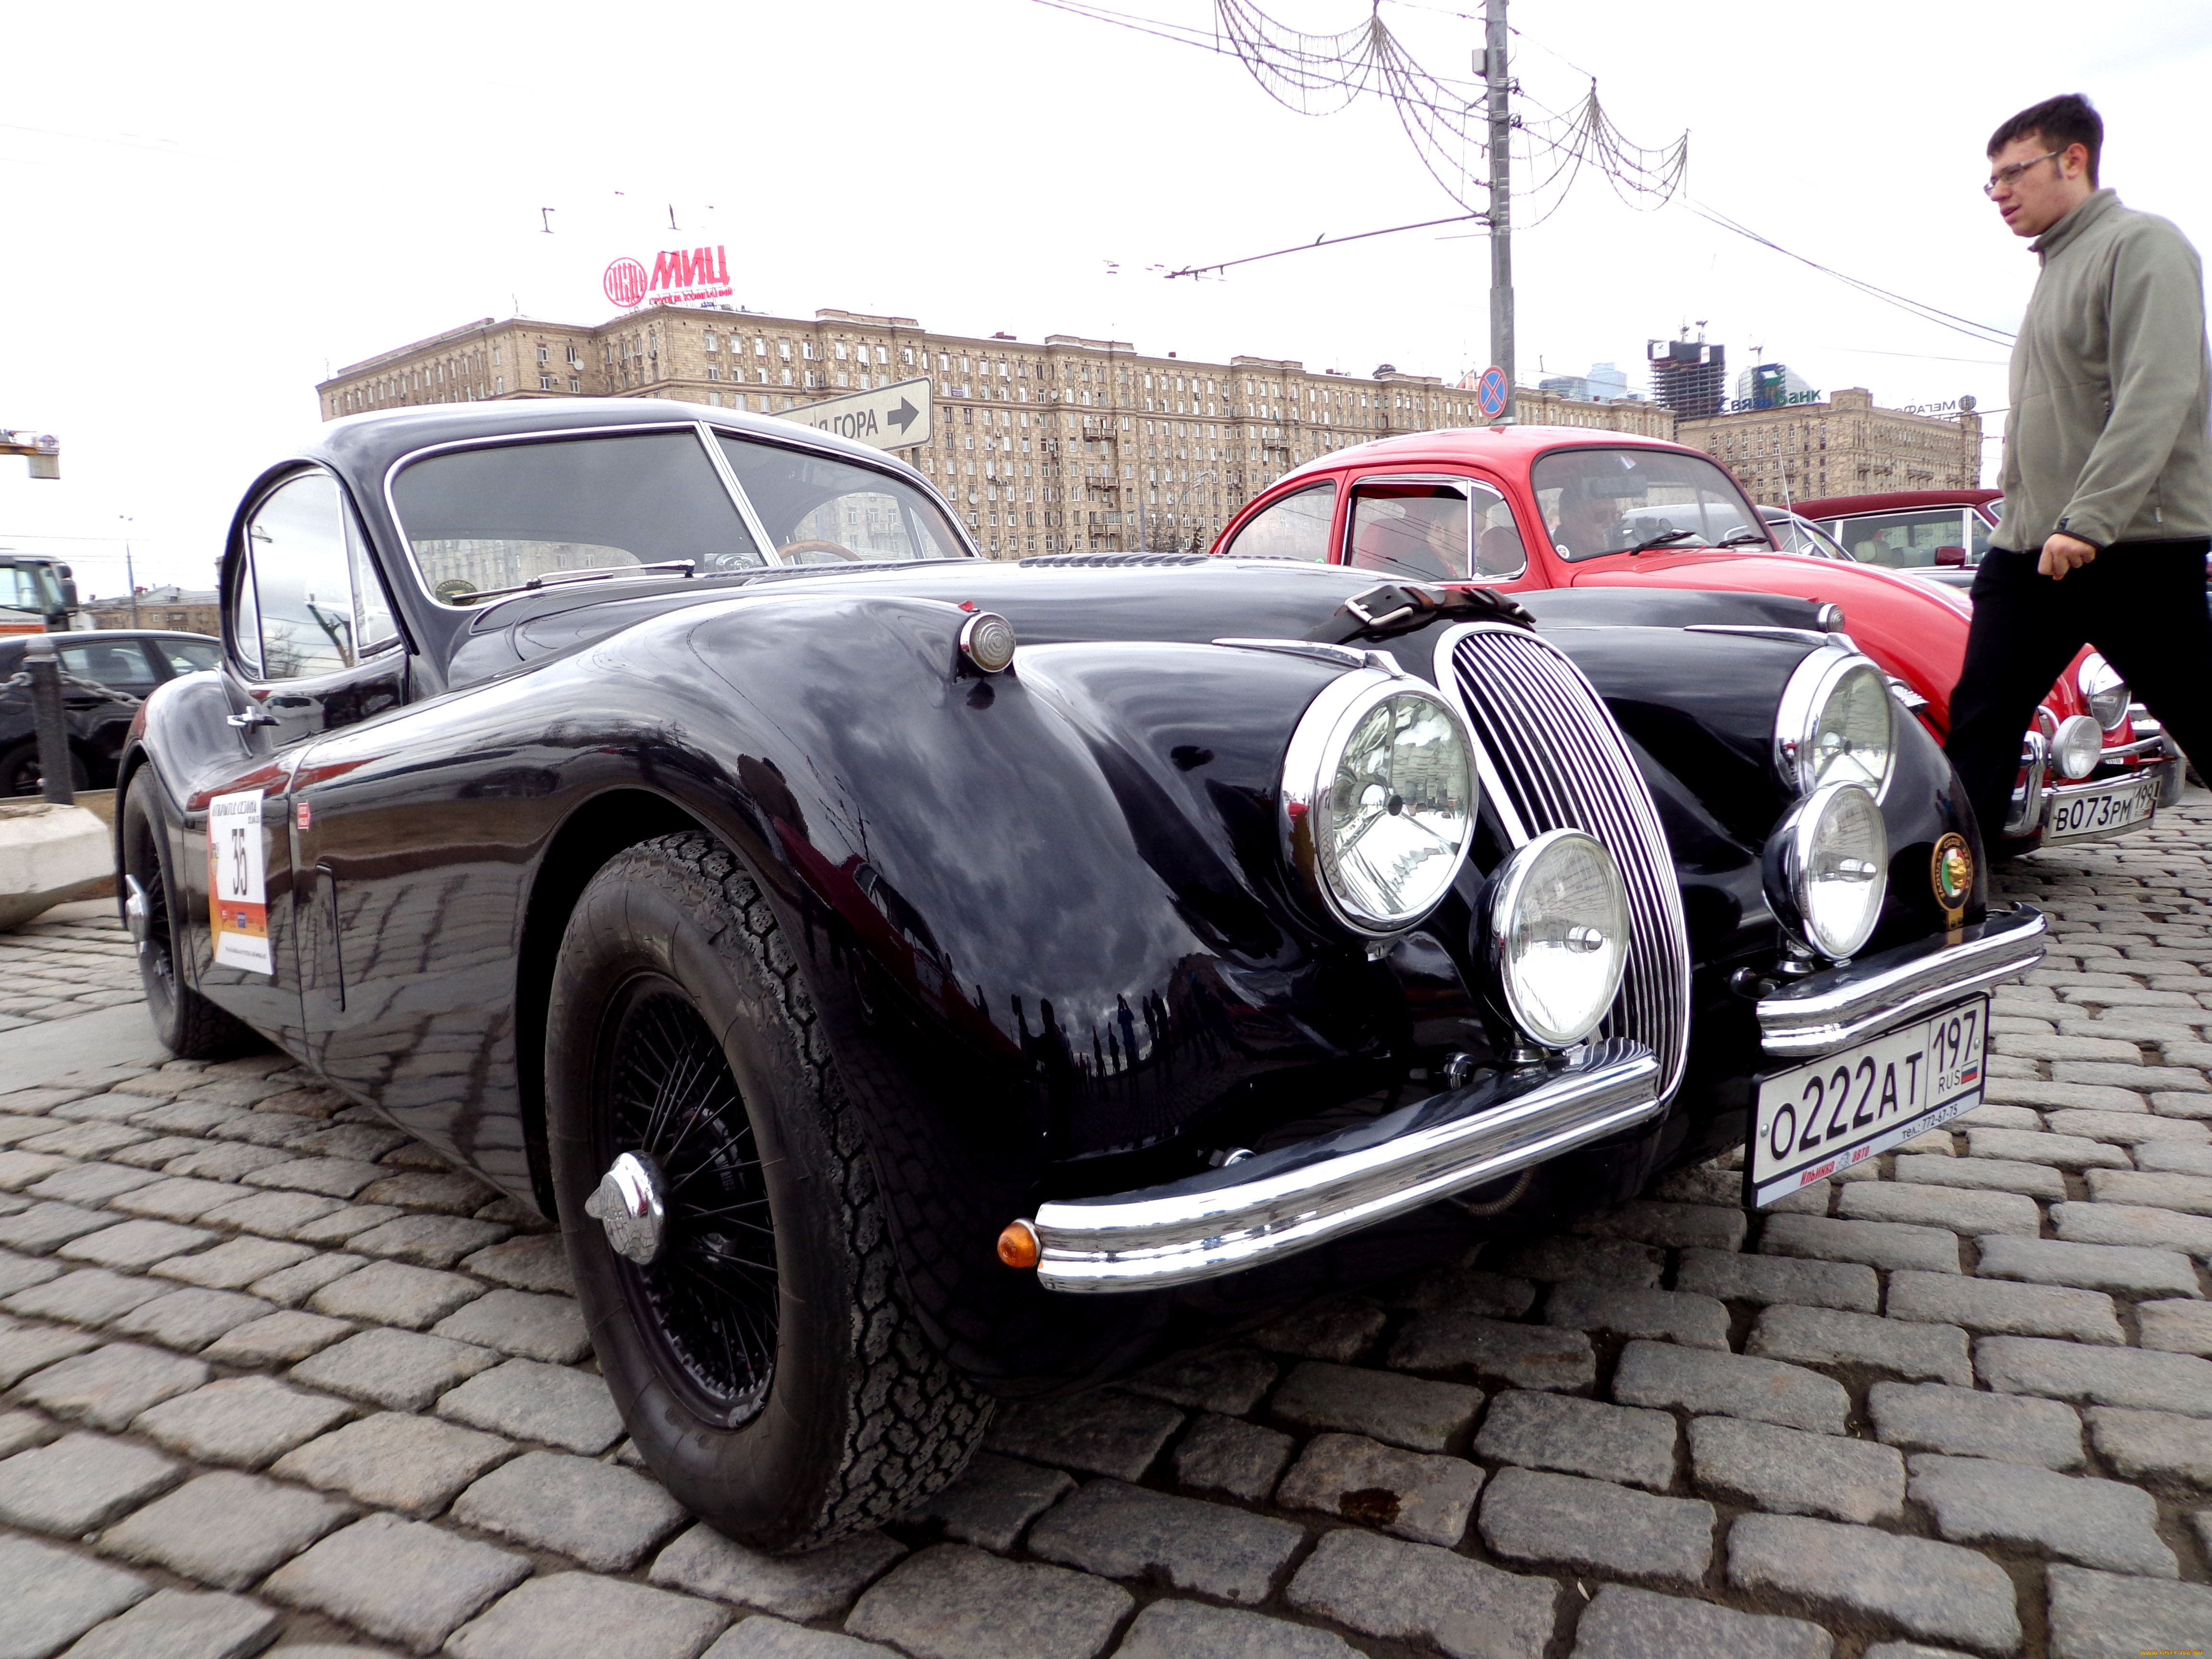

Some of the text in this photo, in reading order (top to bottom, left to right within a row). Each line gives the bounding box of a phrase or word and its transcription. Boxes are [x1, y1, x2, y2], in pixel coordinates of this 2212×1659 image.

[649, 245, 730, 290] МИЦ
[834, 409, 878, 439] ГОРА
[2056, 795, 2132, 831] В073РМ
[2135, 783, 2153, 809] 199
[231, 829, 247, 896] 35
[1933, 1009, 1977, 1073] 197
[1938, 1070, 1960, 1094] RUS
[1770, 1051, 1923, 1161] О222АТ
[1923, 1103, 1958, 1130] 772-67-75
